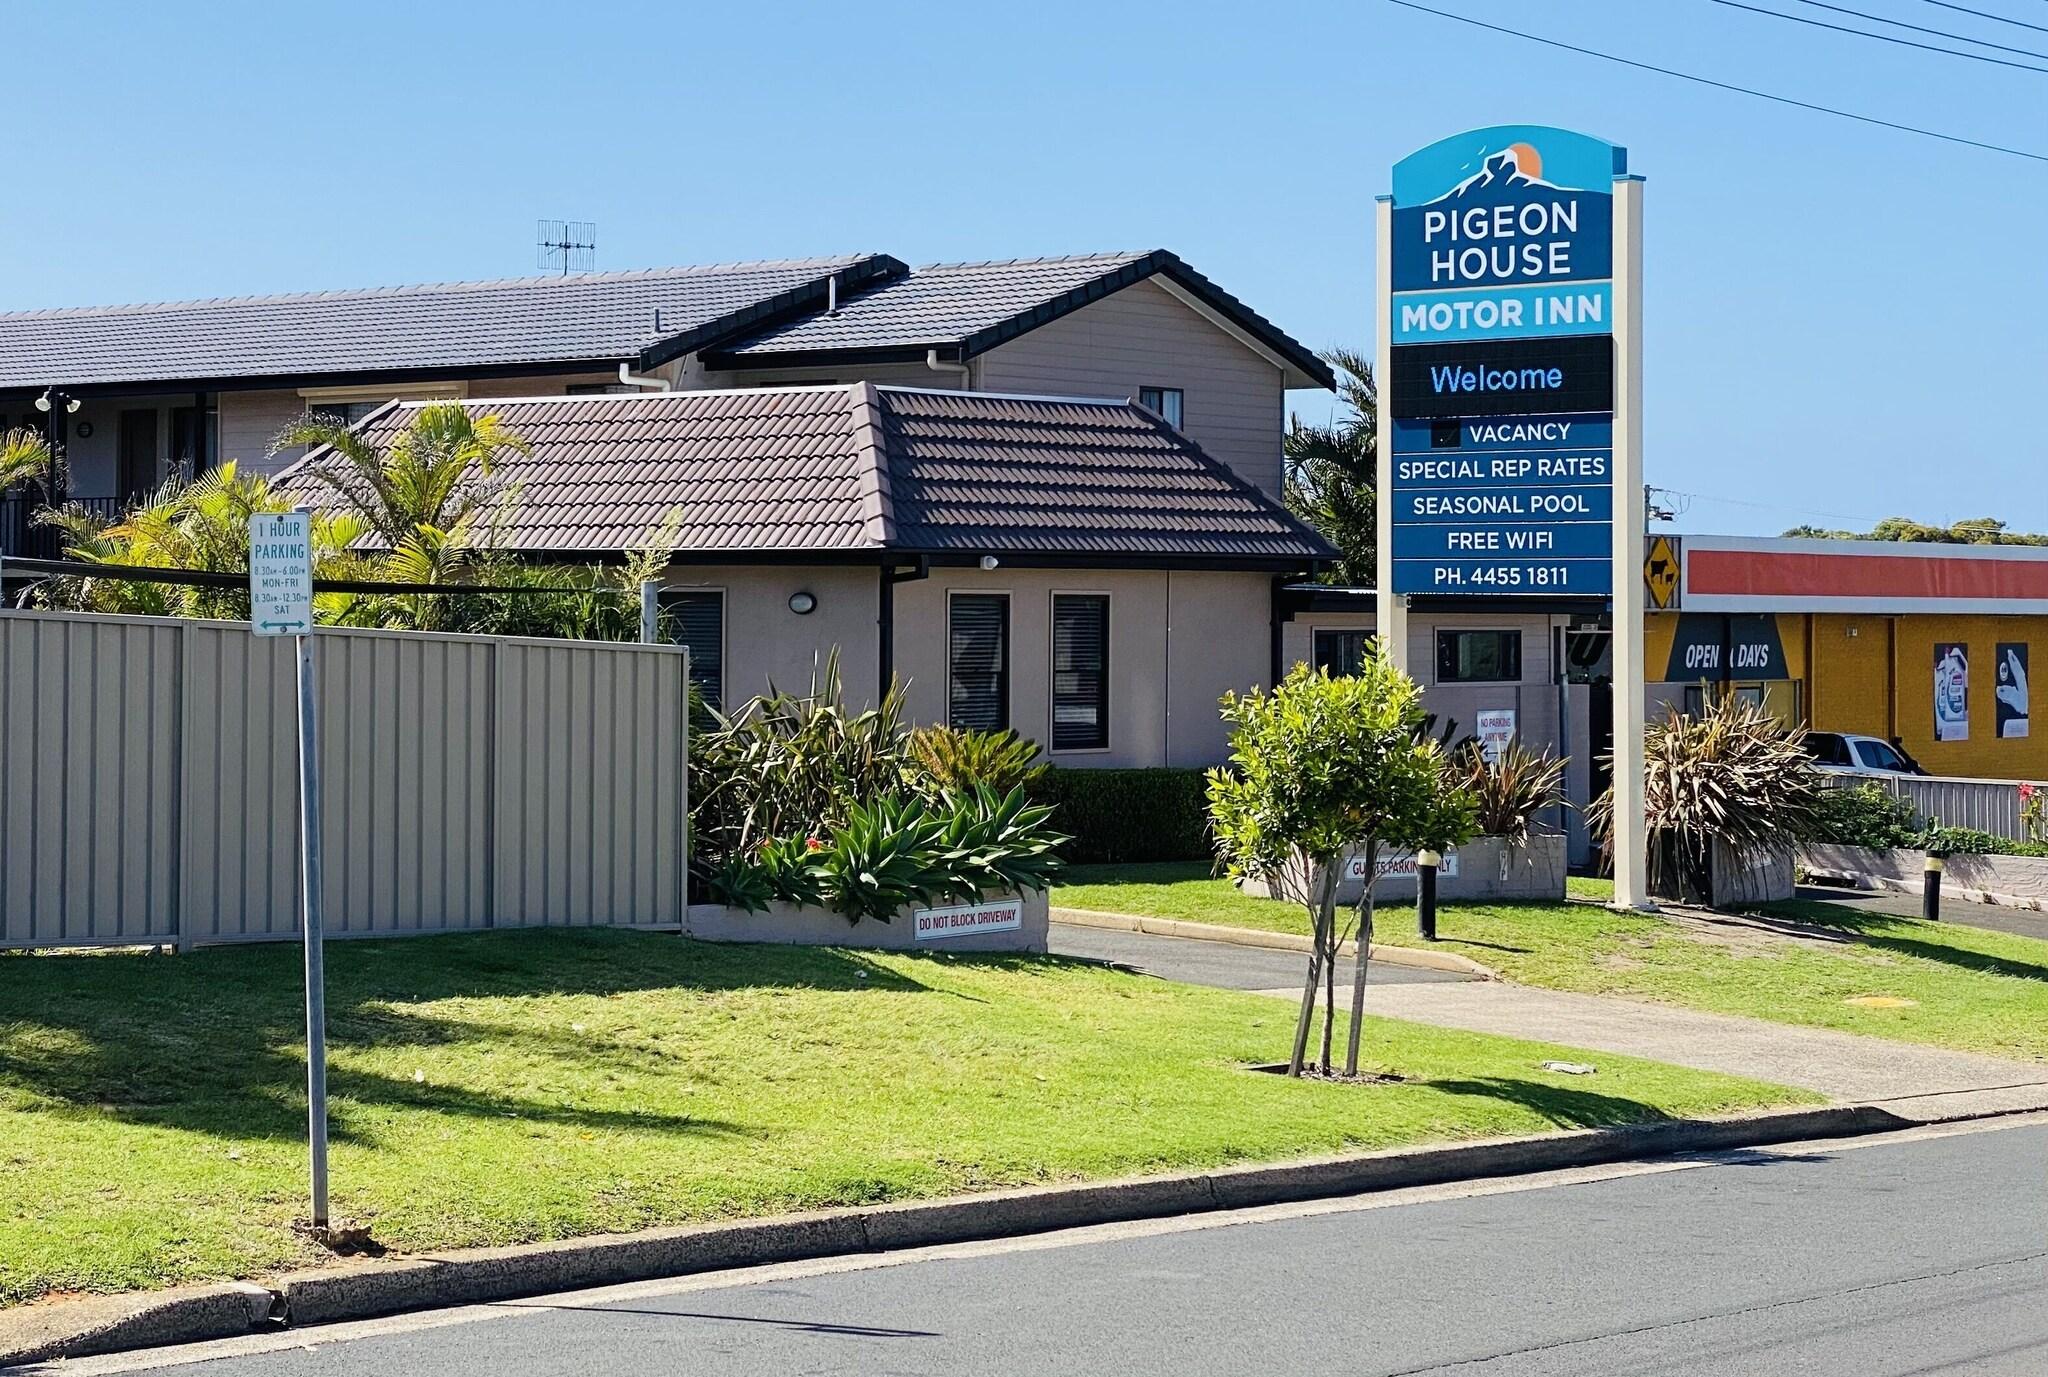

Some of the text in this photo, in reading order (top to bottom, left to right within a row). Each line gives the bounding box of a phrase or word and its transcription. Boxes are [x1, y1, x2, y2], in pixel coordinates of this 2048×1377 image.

[1424, 201, 1577, 243] PIGEON
[1432, 242, 1571, 282] HOUSE
[1402, 294, 1602, 332] MOTOR INN
[1431, 365, 1563, 393] Welcome
[1469, 422, 1571, 443] VACANCY
[1399, 457, 1605, 480] SPECIAL REP RATES
[1413, 494, 1590, 515] SEASONAL POOL
[259, 521, 300, 537] 1 HOUR
[1448, 531, 1553, 550] FREE WIFI
[255, 544, 305, 559] PARKING
[262, 578, 299, 588] MON-FRI
[1434, 567, 1568, 585] PH. 4455 1811
[274, 605, 290, 615] SAT
[1685, 644, 1720, 669] OPEN
[1737, 644, 1769, 668] DAYS
[1480, 717, 1512, 728] NO PARKING
[1352, 861, 1387, 876] GUTS
[1387, 859, 1419, 875] PARKIN
[919, 909, 1016, 930] DO NOT BLOCK DRIVEWAY
